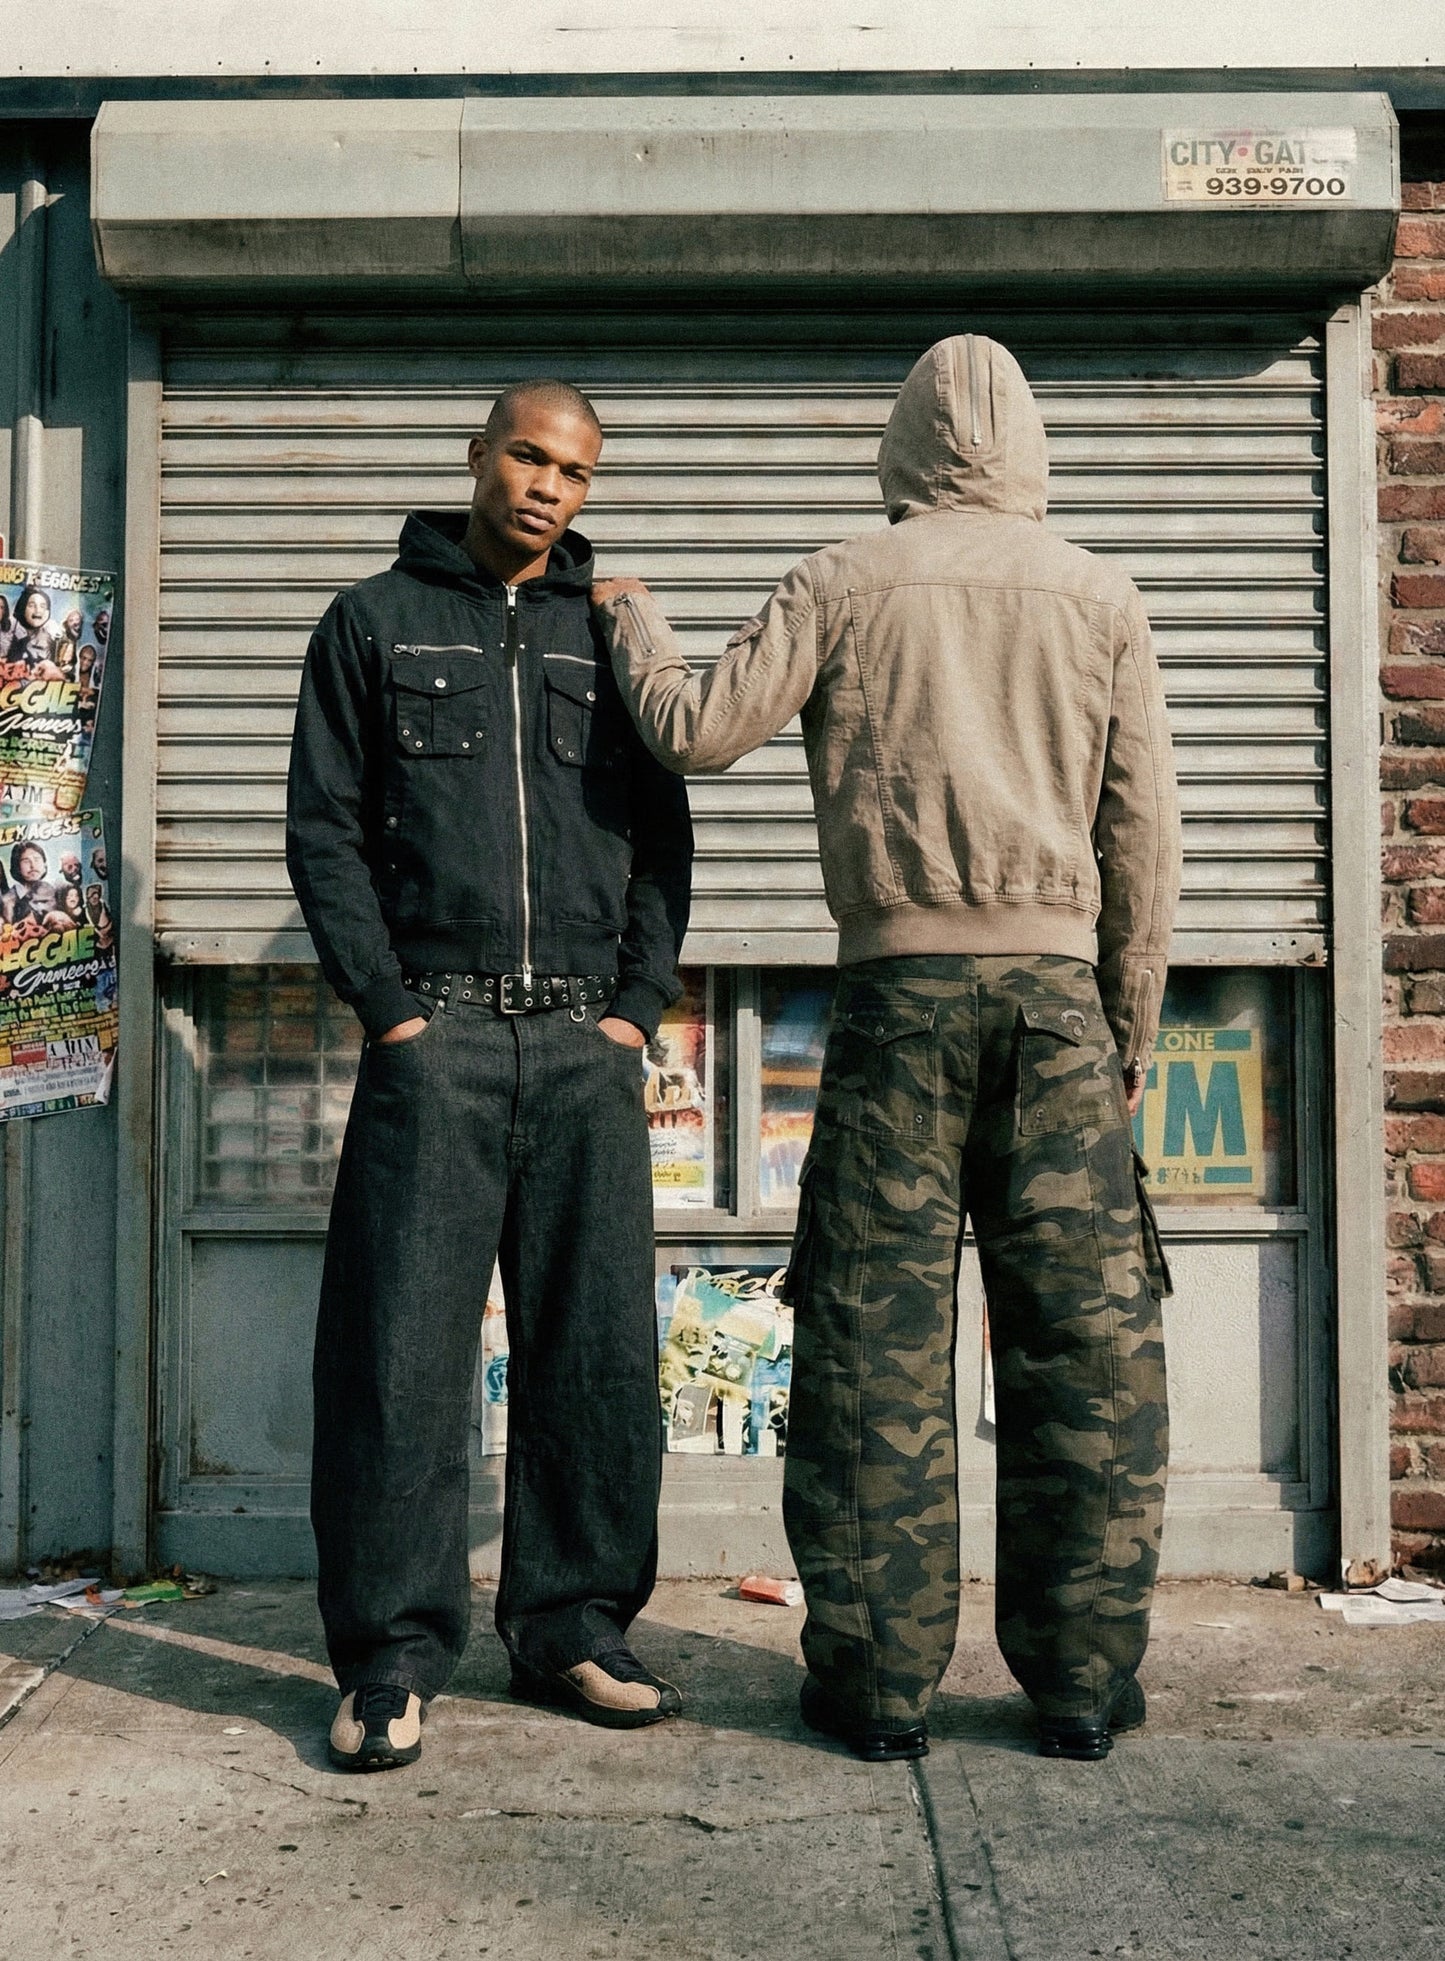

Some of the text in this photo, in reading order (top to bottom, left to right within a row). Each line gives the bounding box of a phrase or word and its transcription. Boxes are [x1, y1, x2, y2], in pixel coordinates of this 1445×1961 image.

[1170, 140, 1236, 166] CITY
[0, 927, 95, 973] EGGAE
[1164, 1032, 1215, 1051] ONE
